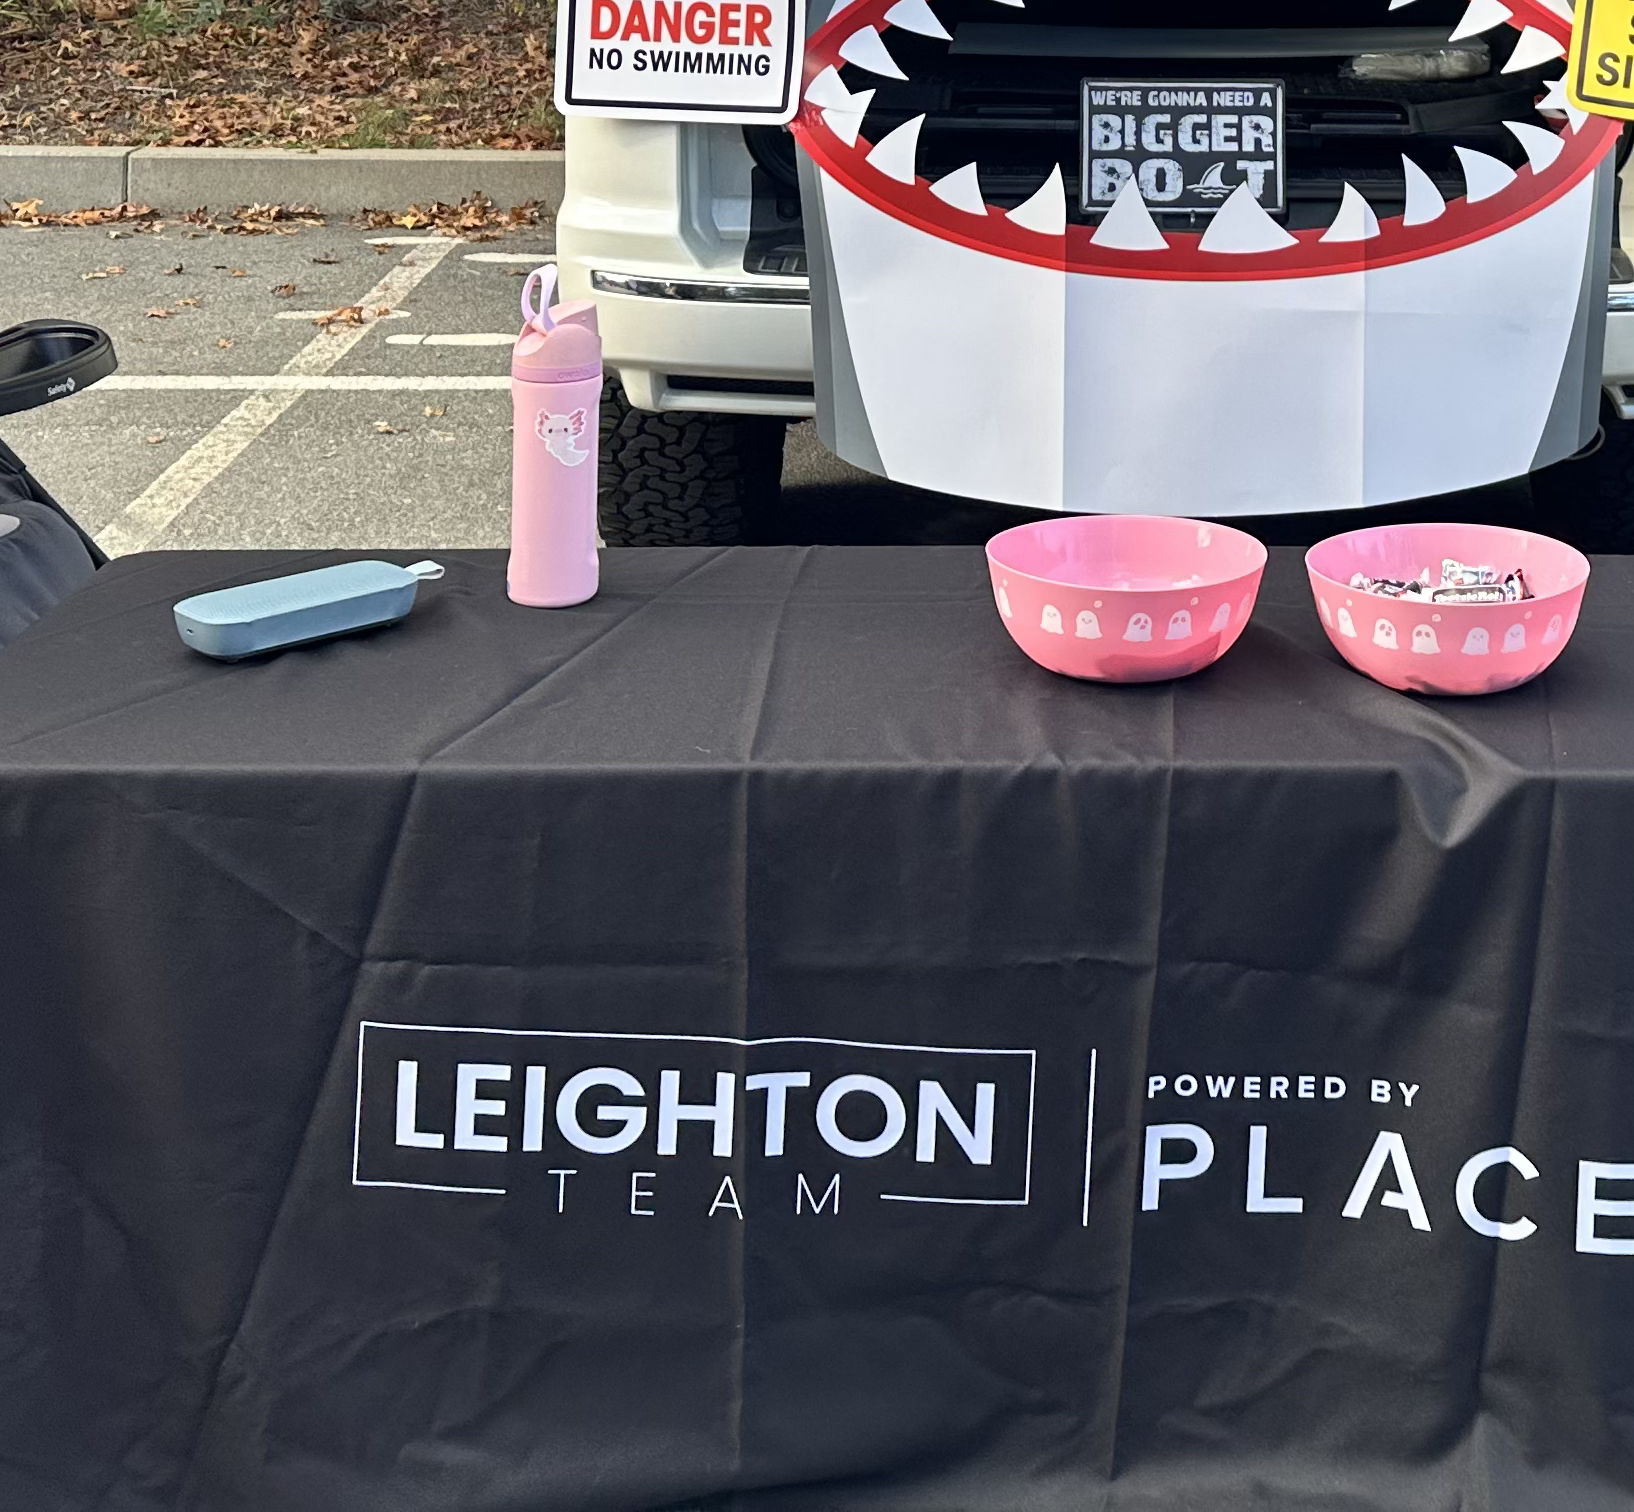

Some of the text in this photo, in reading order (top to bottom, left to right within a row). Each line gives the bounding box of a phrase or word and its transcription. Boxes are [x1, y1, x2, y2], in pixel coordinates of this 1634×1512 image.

[588, 48, 771, 76] NO SWIMMING
[1091, 90, 1273, 107] WE'RE GONNA NEED A
[1091, 113, 1275, 152] BIGGER
[1147, 1075, 1420, 1107] POWERED BY
[395, 1060, 995, 1166] LEIGHTON
[547, 1169, 840, 1220] TEAM
